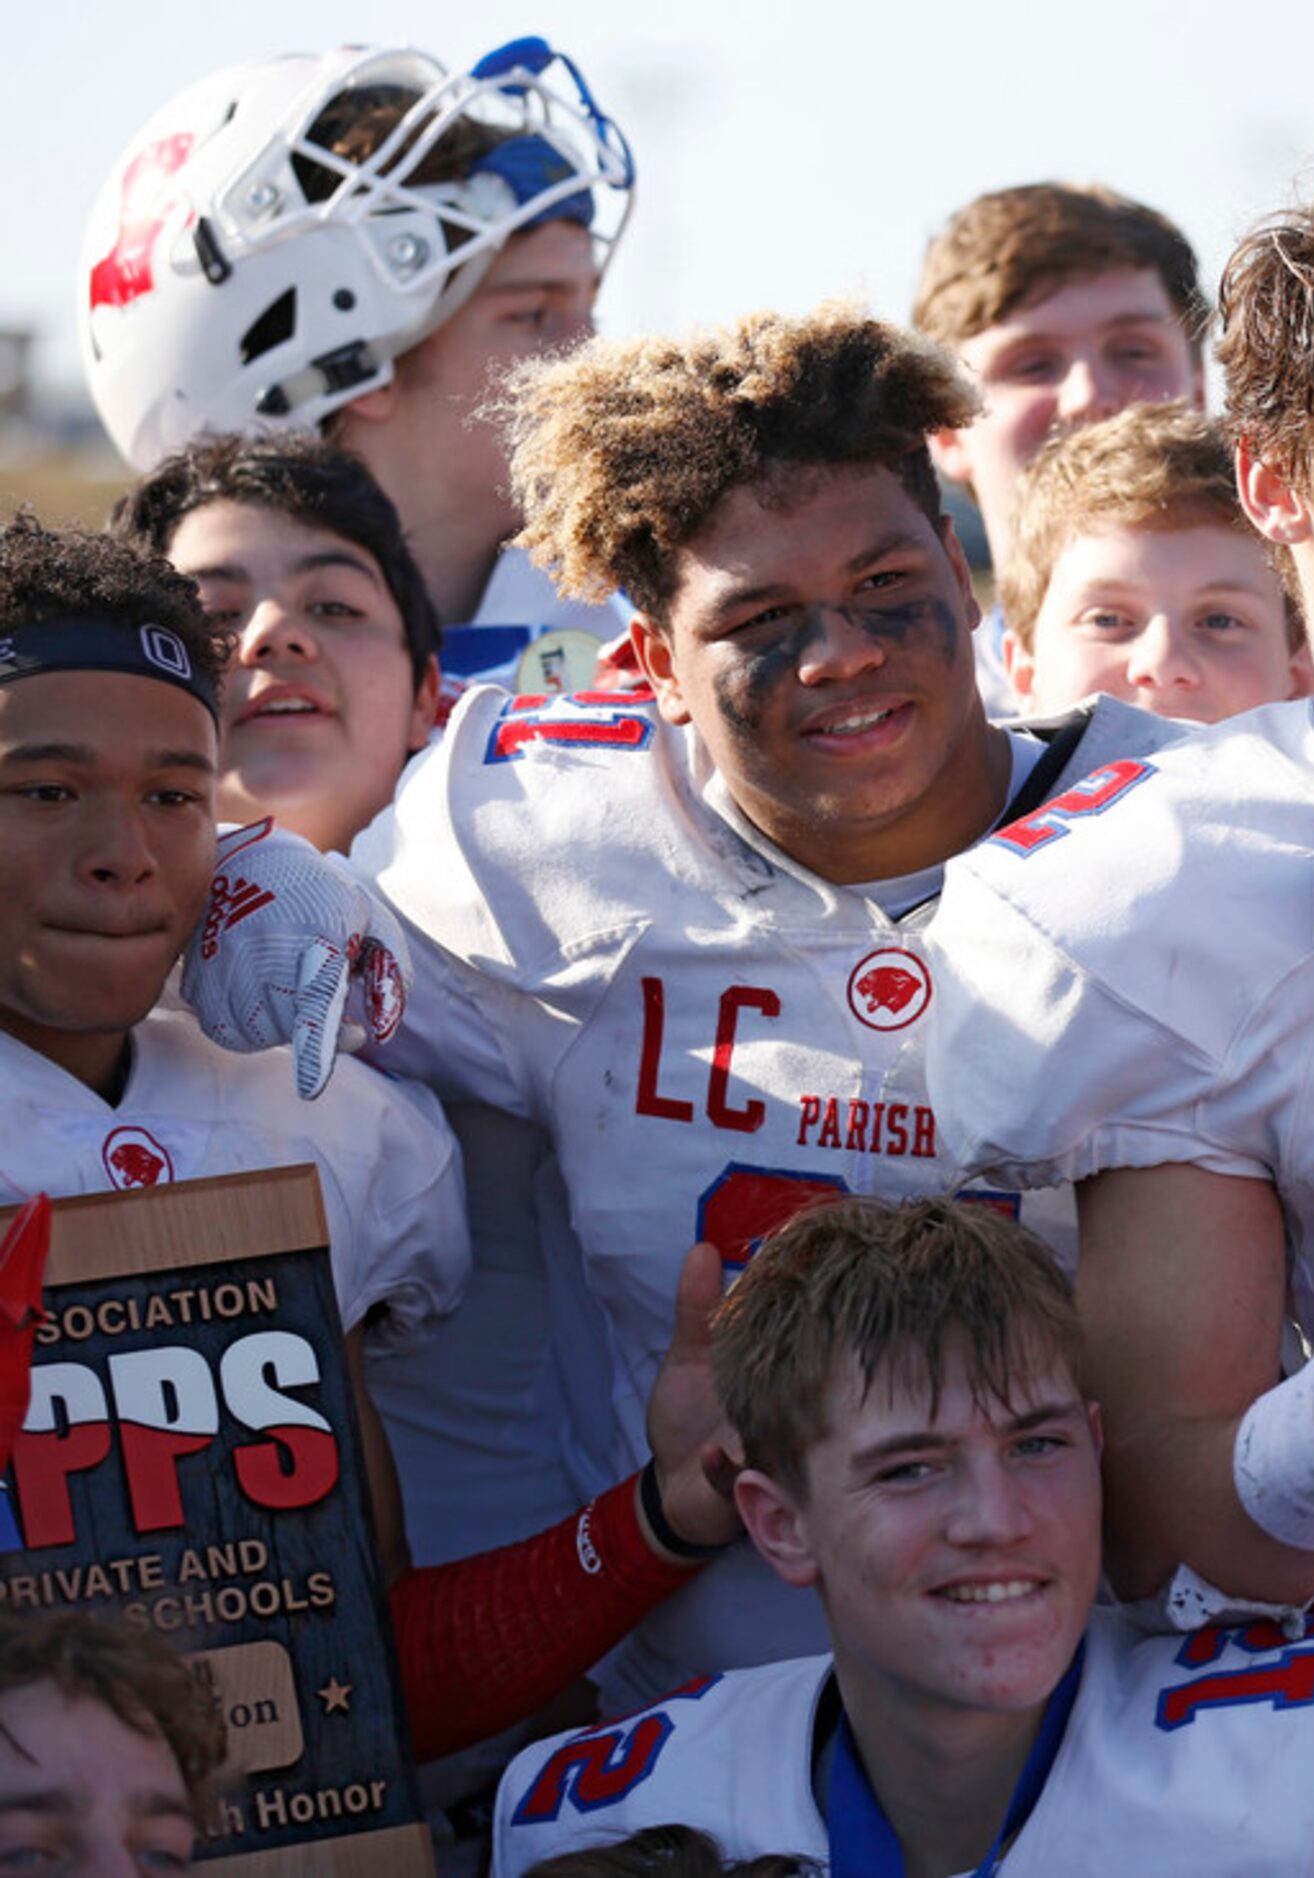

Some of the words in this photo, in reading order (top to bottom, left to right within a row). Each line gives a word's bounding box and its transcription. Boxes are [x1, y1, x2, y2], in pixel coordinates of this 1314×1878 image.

[796, 1093, 937, 1158] PARISH
[0, 1330, 340, 1549] PPS
[179, 1539, 268, 1584] AND
[125, 1572, 336, 1633] SCHOOLS
[257, 1780, 387, 1828] Honor
